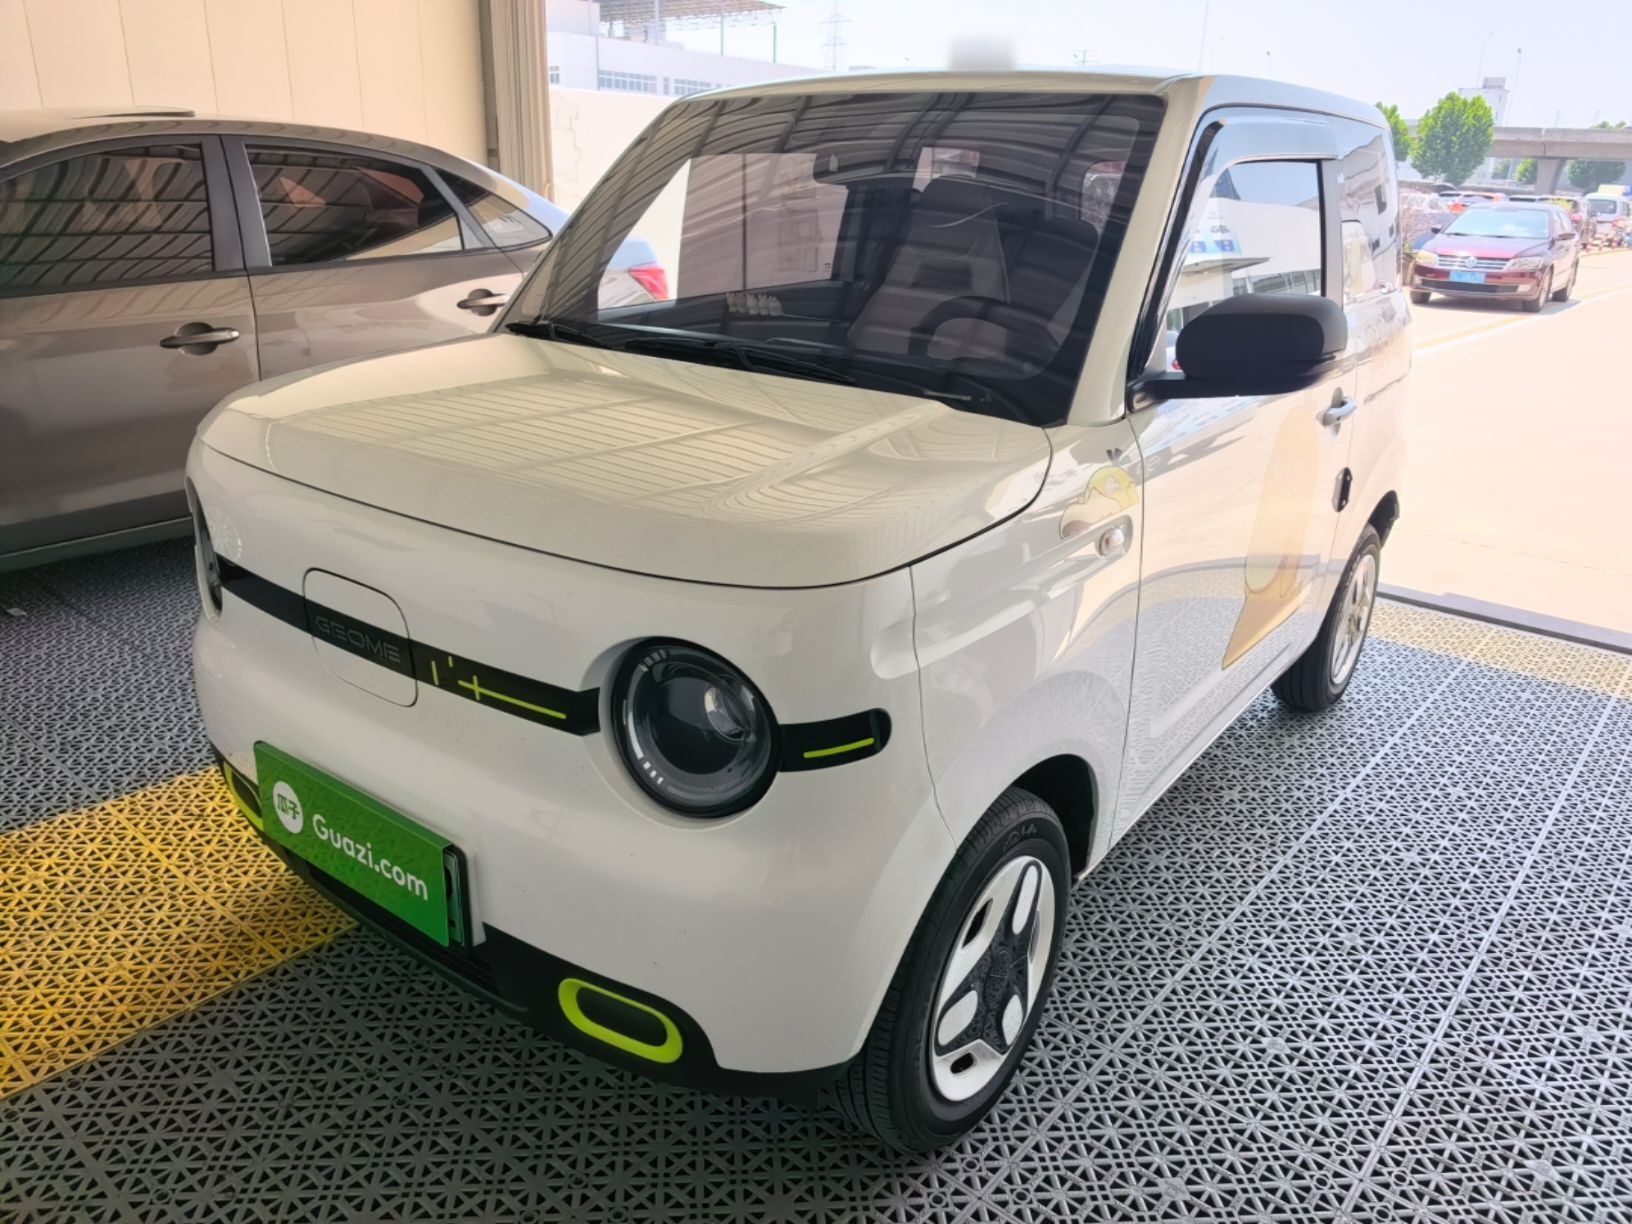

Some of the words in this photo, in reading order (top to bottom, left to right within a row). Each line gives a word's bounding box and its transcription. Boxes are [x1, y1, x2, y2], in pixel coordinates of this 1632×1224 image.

[315, 616, 401, 663] GEOME
[277, 793, 300, 820] 瓜子
[312, 814, 428, 901] Guazi.com
